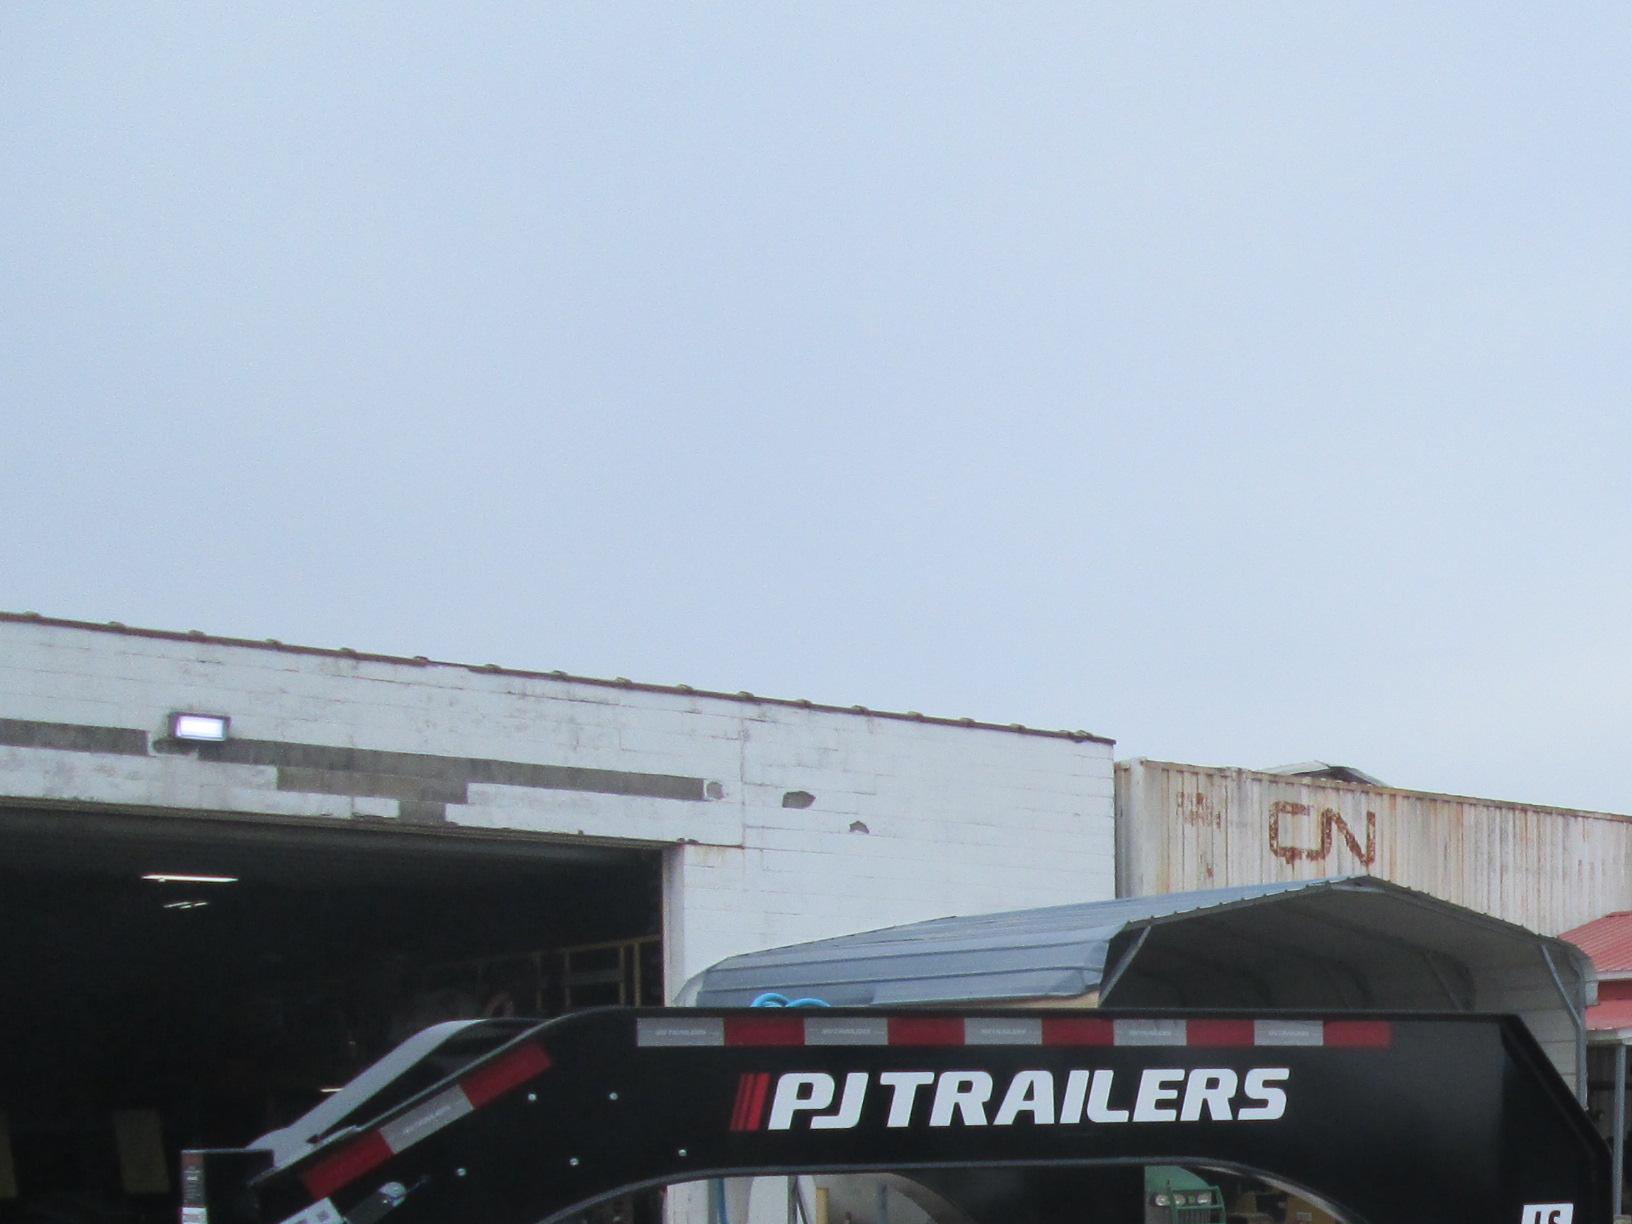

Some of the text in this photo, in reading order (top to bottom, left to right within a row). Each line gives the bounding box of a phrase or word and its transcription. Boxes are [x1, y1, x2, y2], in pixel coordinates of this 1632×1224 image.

[1269, 800, 1376, 866] CN
[767, 1068, 1290, 1130] PJ TRAILERS
